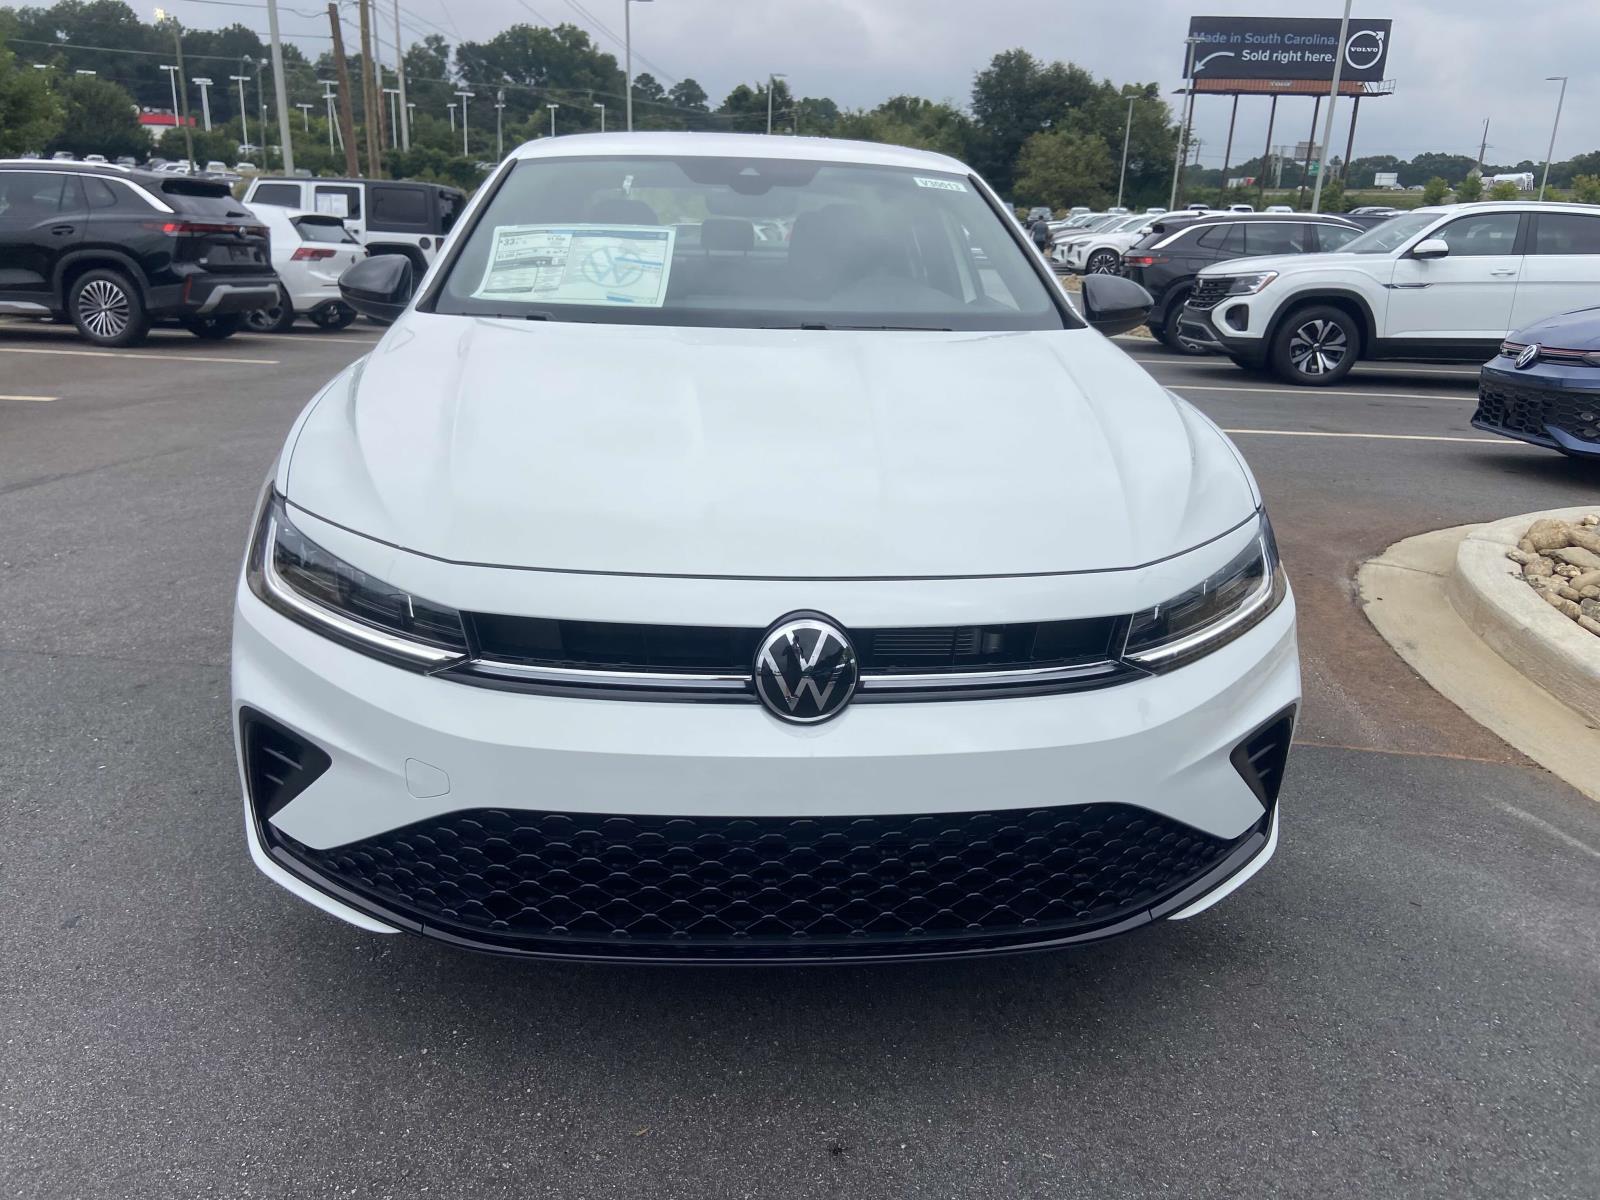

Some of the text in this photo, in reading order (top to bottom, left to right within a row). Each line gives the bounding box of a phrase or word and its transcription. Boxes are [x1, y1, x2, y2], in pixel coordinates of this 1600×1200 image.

[1193, 32, 1339, 45] Made in South Carolina.
[1241, 49, 1336, 63] Sold right here.
